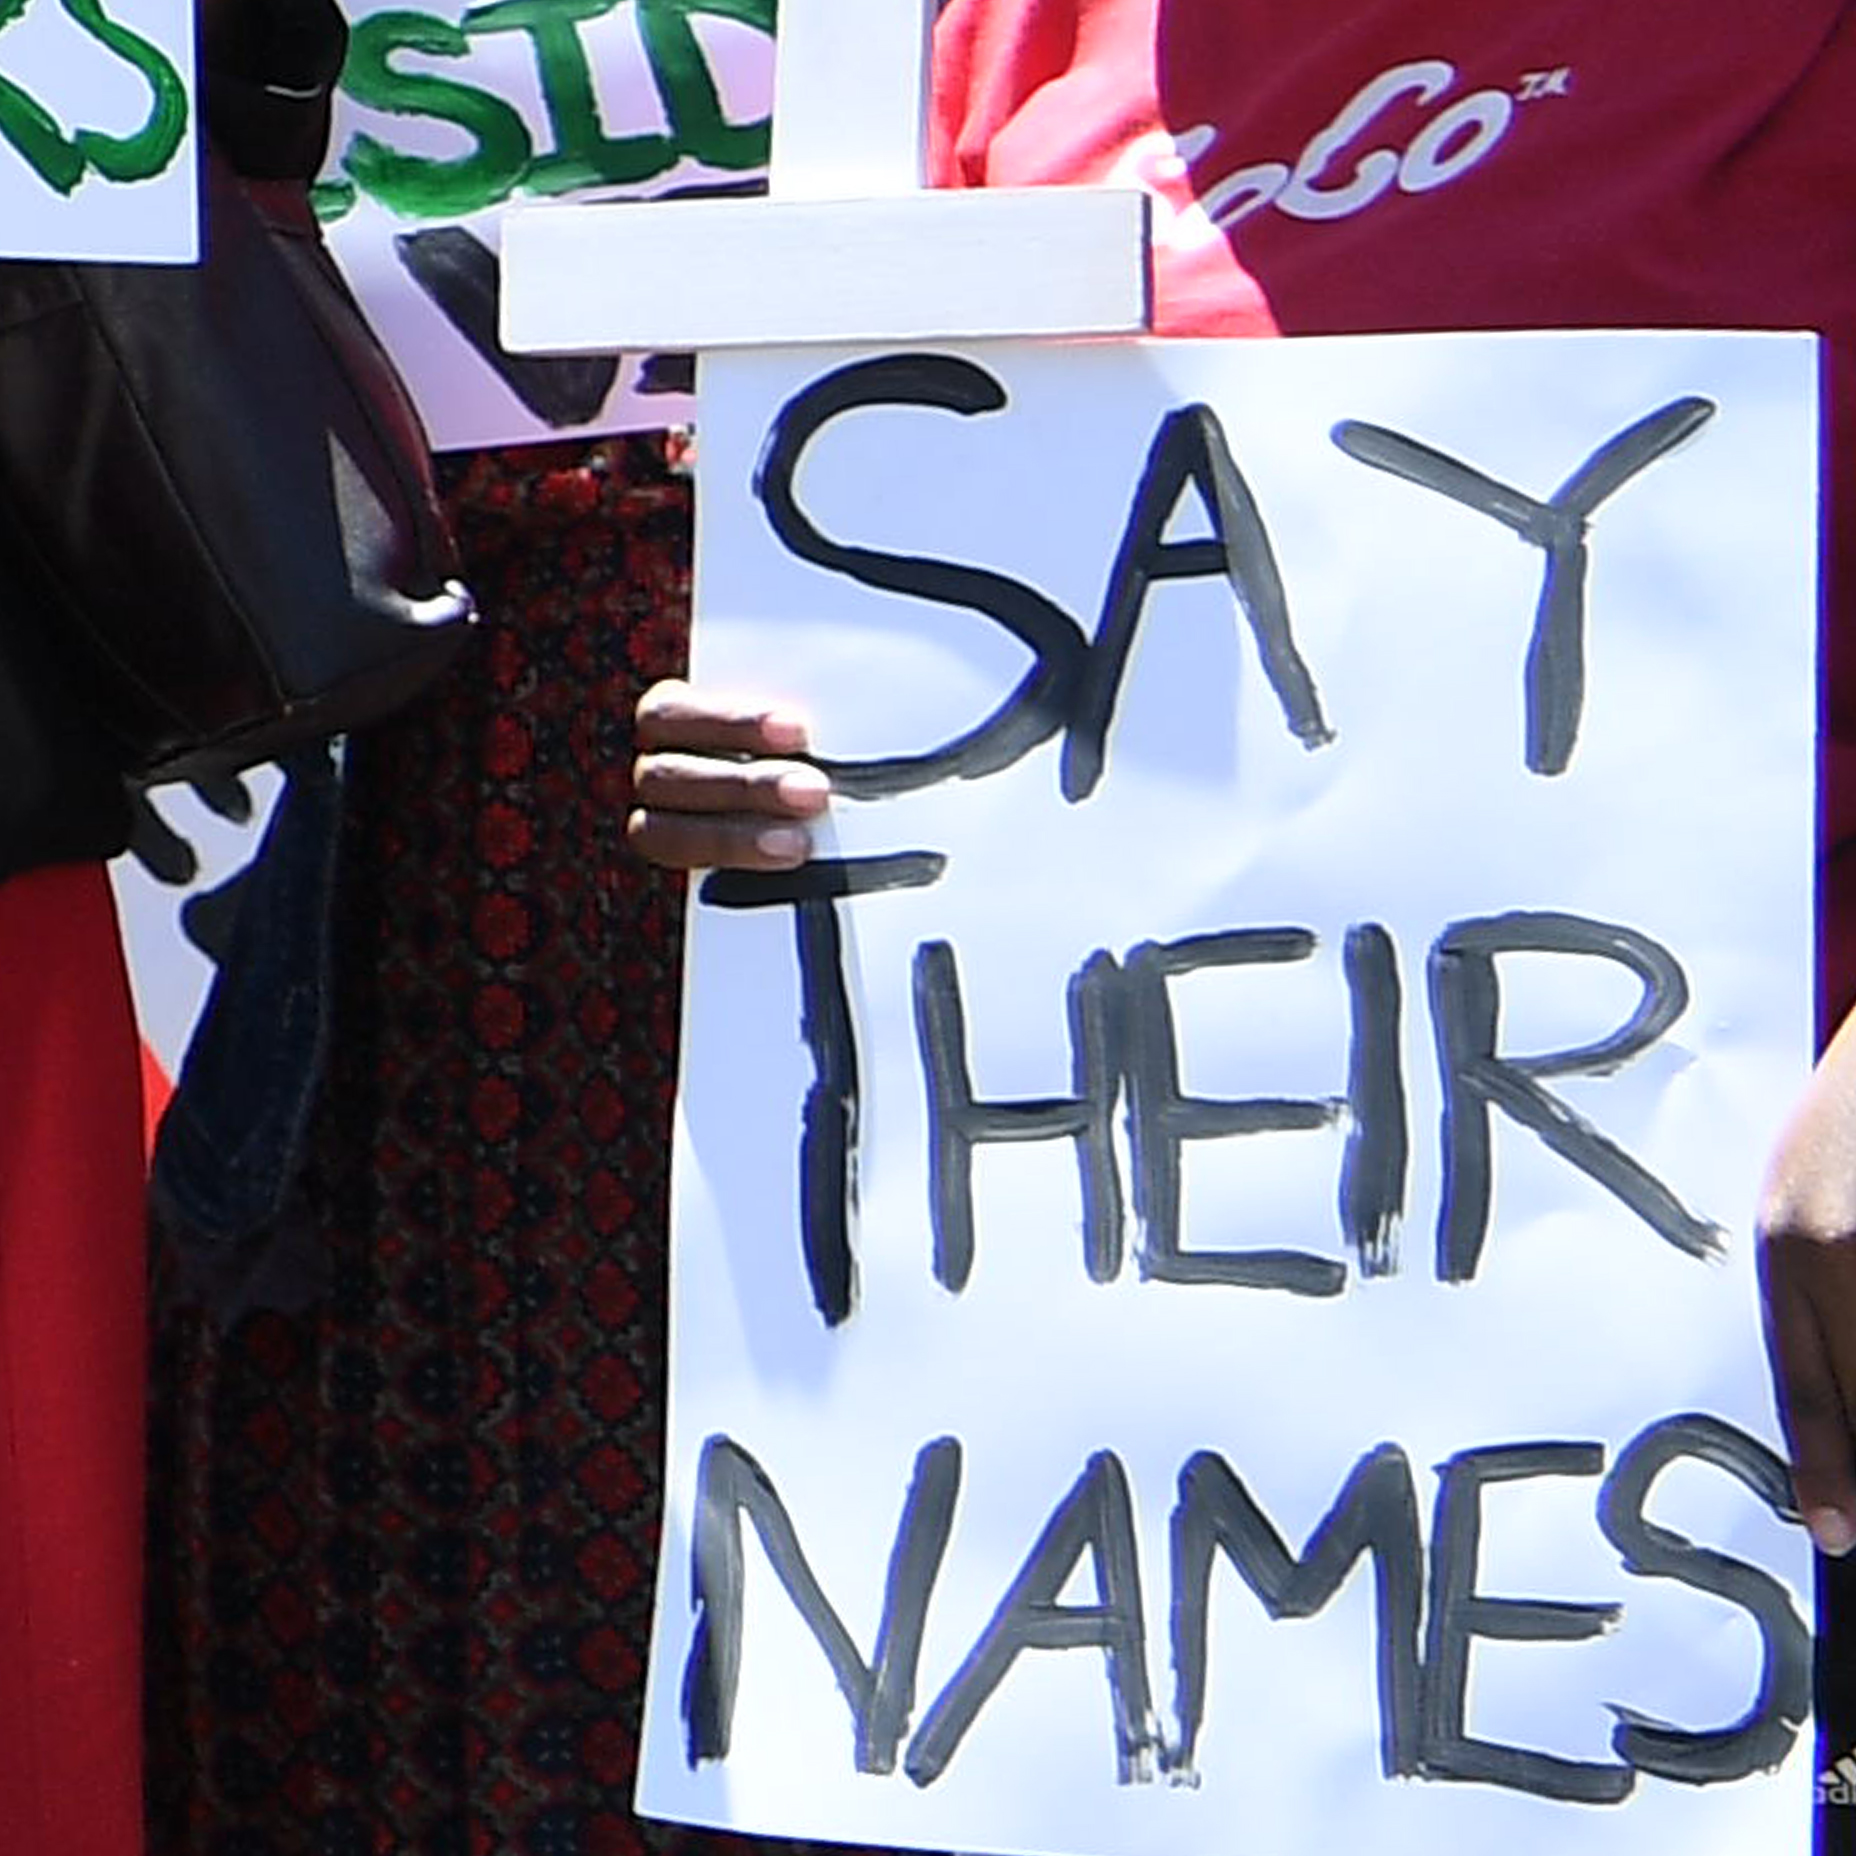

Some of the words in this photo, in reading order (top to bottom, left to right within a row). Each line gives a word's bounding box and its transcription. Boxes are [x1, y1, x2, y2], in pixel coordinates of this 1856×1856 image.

[754, 352, 1716, 803] SAY
[699, 849, 1730, 1328] THEIR
[683, 1412, 1812, 1805] NAMES
